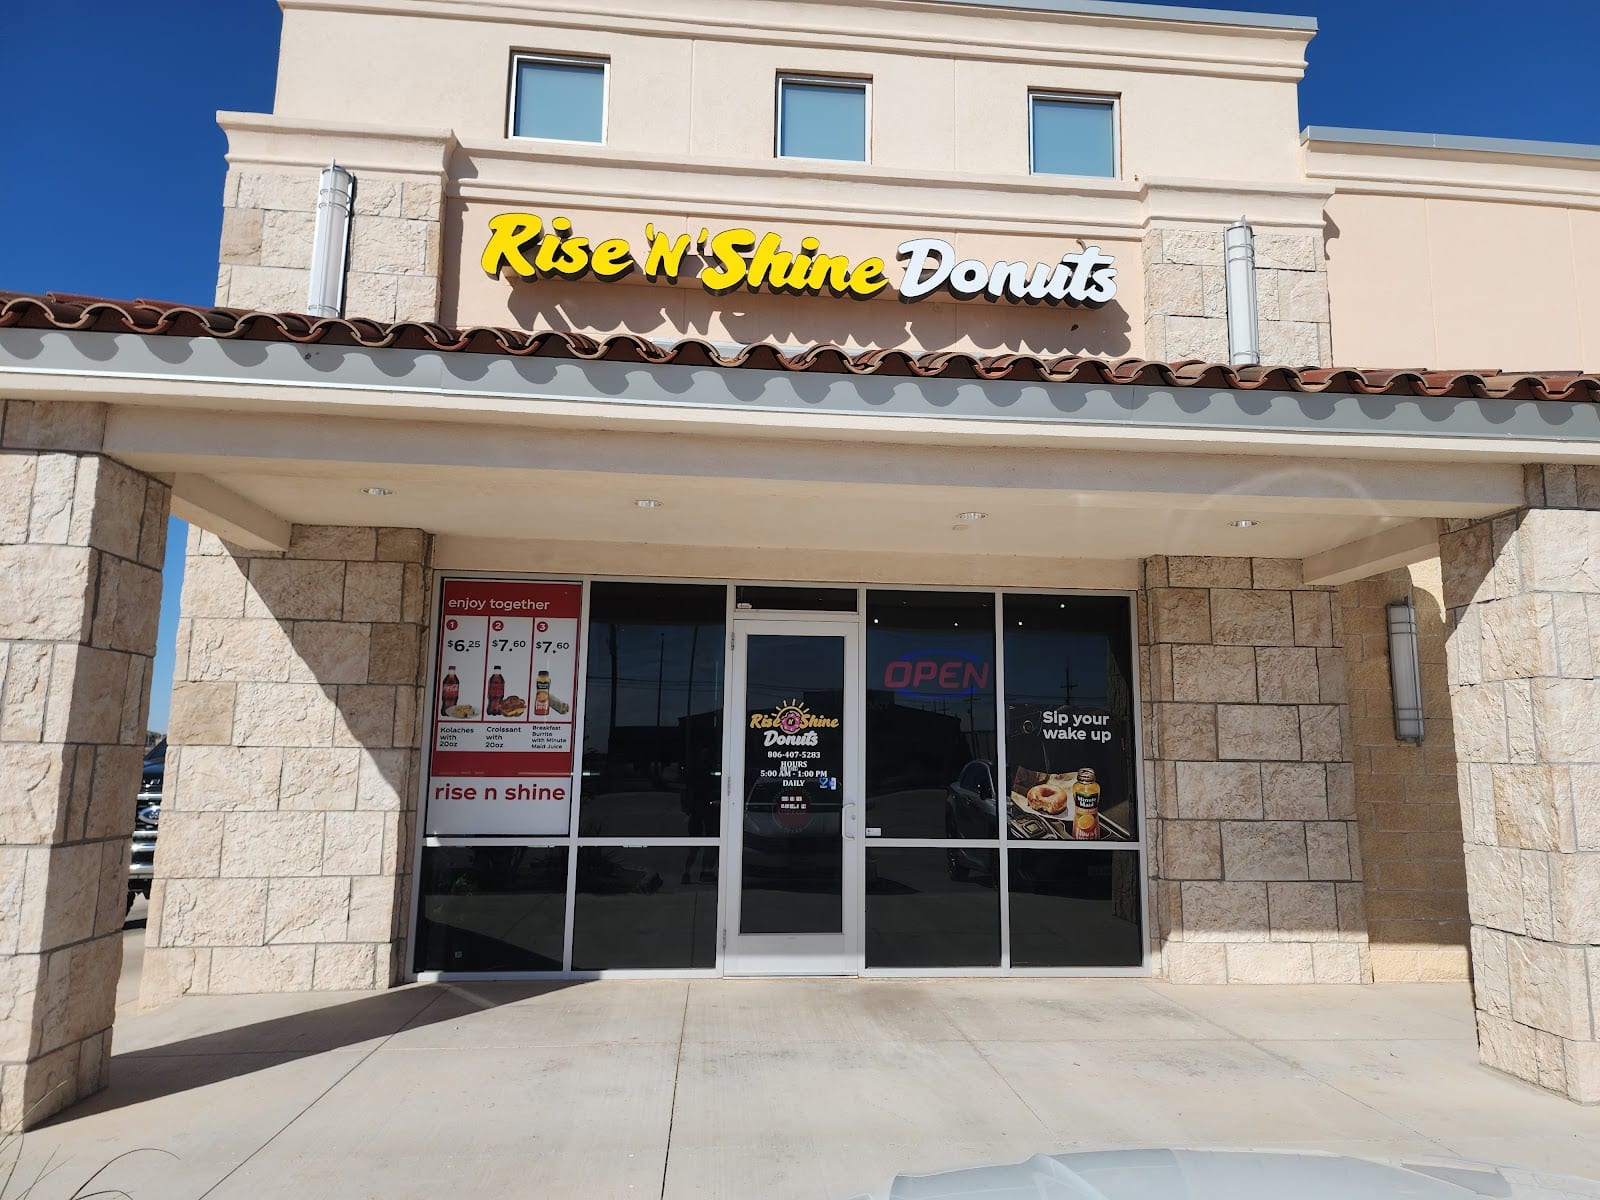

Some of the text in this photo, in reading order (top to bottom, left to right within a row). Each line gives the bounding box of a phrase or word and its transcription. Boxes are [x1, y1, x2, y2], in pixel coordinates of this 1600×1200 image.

[481, 212, 635, 280] Rise
[702, 228, 890, 295] Shine
[898, 237, 1119, 306] Donuts
[448, 597, 550, 611] enjoy together
[447, 639, 481, 652] $6.25
[884, 661, 989, 689] OPEN
[750, 713, 782, 729] Rise
[800, 714, 840, 729] Shine
[1042, 710, 1110, 727] Sip your
[763, 730, 819, 747] Donuts
[1042, 726, 1112, 744] wake up
[767, 751, 821, 759] 806-407-5283
[780, 760, 808, 768] HOURS
[760, 770, 777, 778] 5:00
[778, 770, 792, 778] AM
[797, 770, 814, 778] 1:00
[815, 770, 828, 778] PM
[782, 779, 806, 787] DAILY
[434, 783, 567, 801] rise n shine
